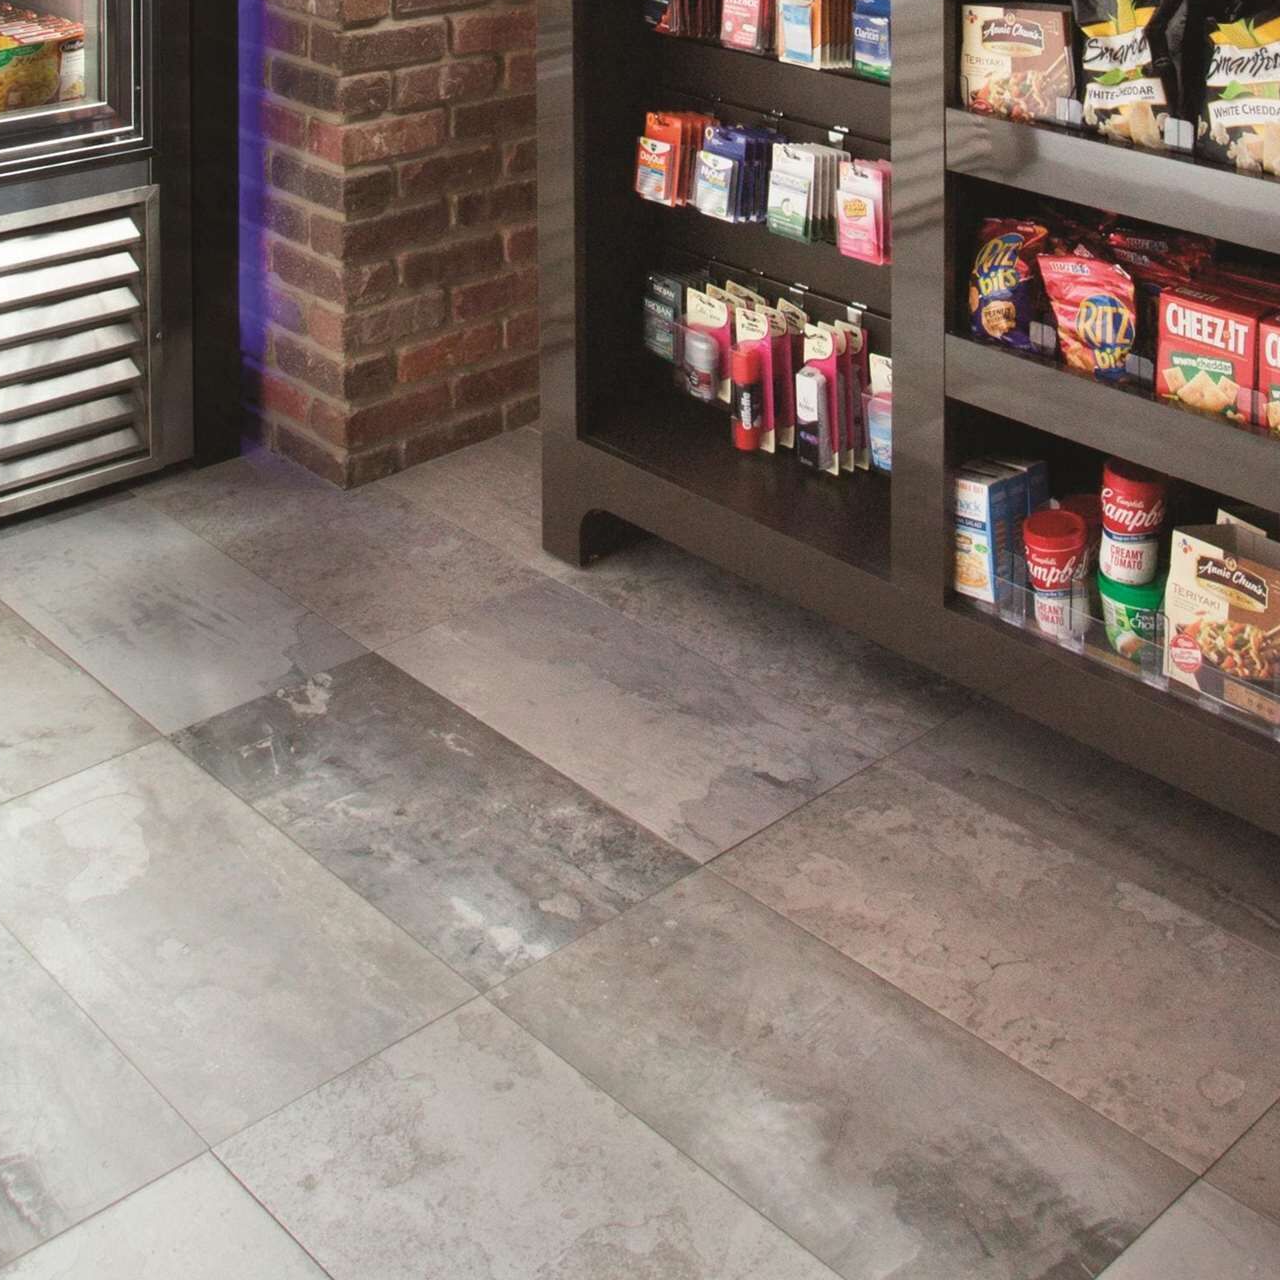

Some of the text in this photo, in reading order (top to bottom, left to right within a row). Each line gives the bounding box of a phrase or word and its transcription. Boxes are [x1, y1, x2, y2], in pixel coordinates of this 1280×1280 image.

[1213, 105, 1241, 119] WHITE
[975, 237, 1022, 275] RITZ
[978, 267, 1018, 297] bits
[1077, 300, 1135, 348] RITZ
[1196, 357, 1233, 375] cheddar
[1110, 544, 1145, 562] CREAMY
[1111, 555, 1143, 571] TOMATO
[1199, 560, 1231, 579] Annie
[1172, 582, 1221, 611] TERIYAKI
